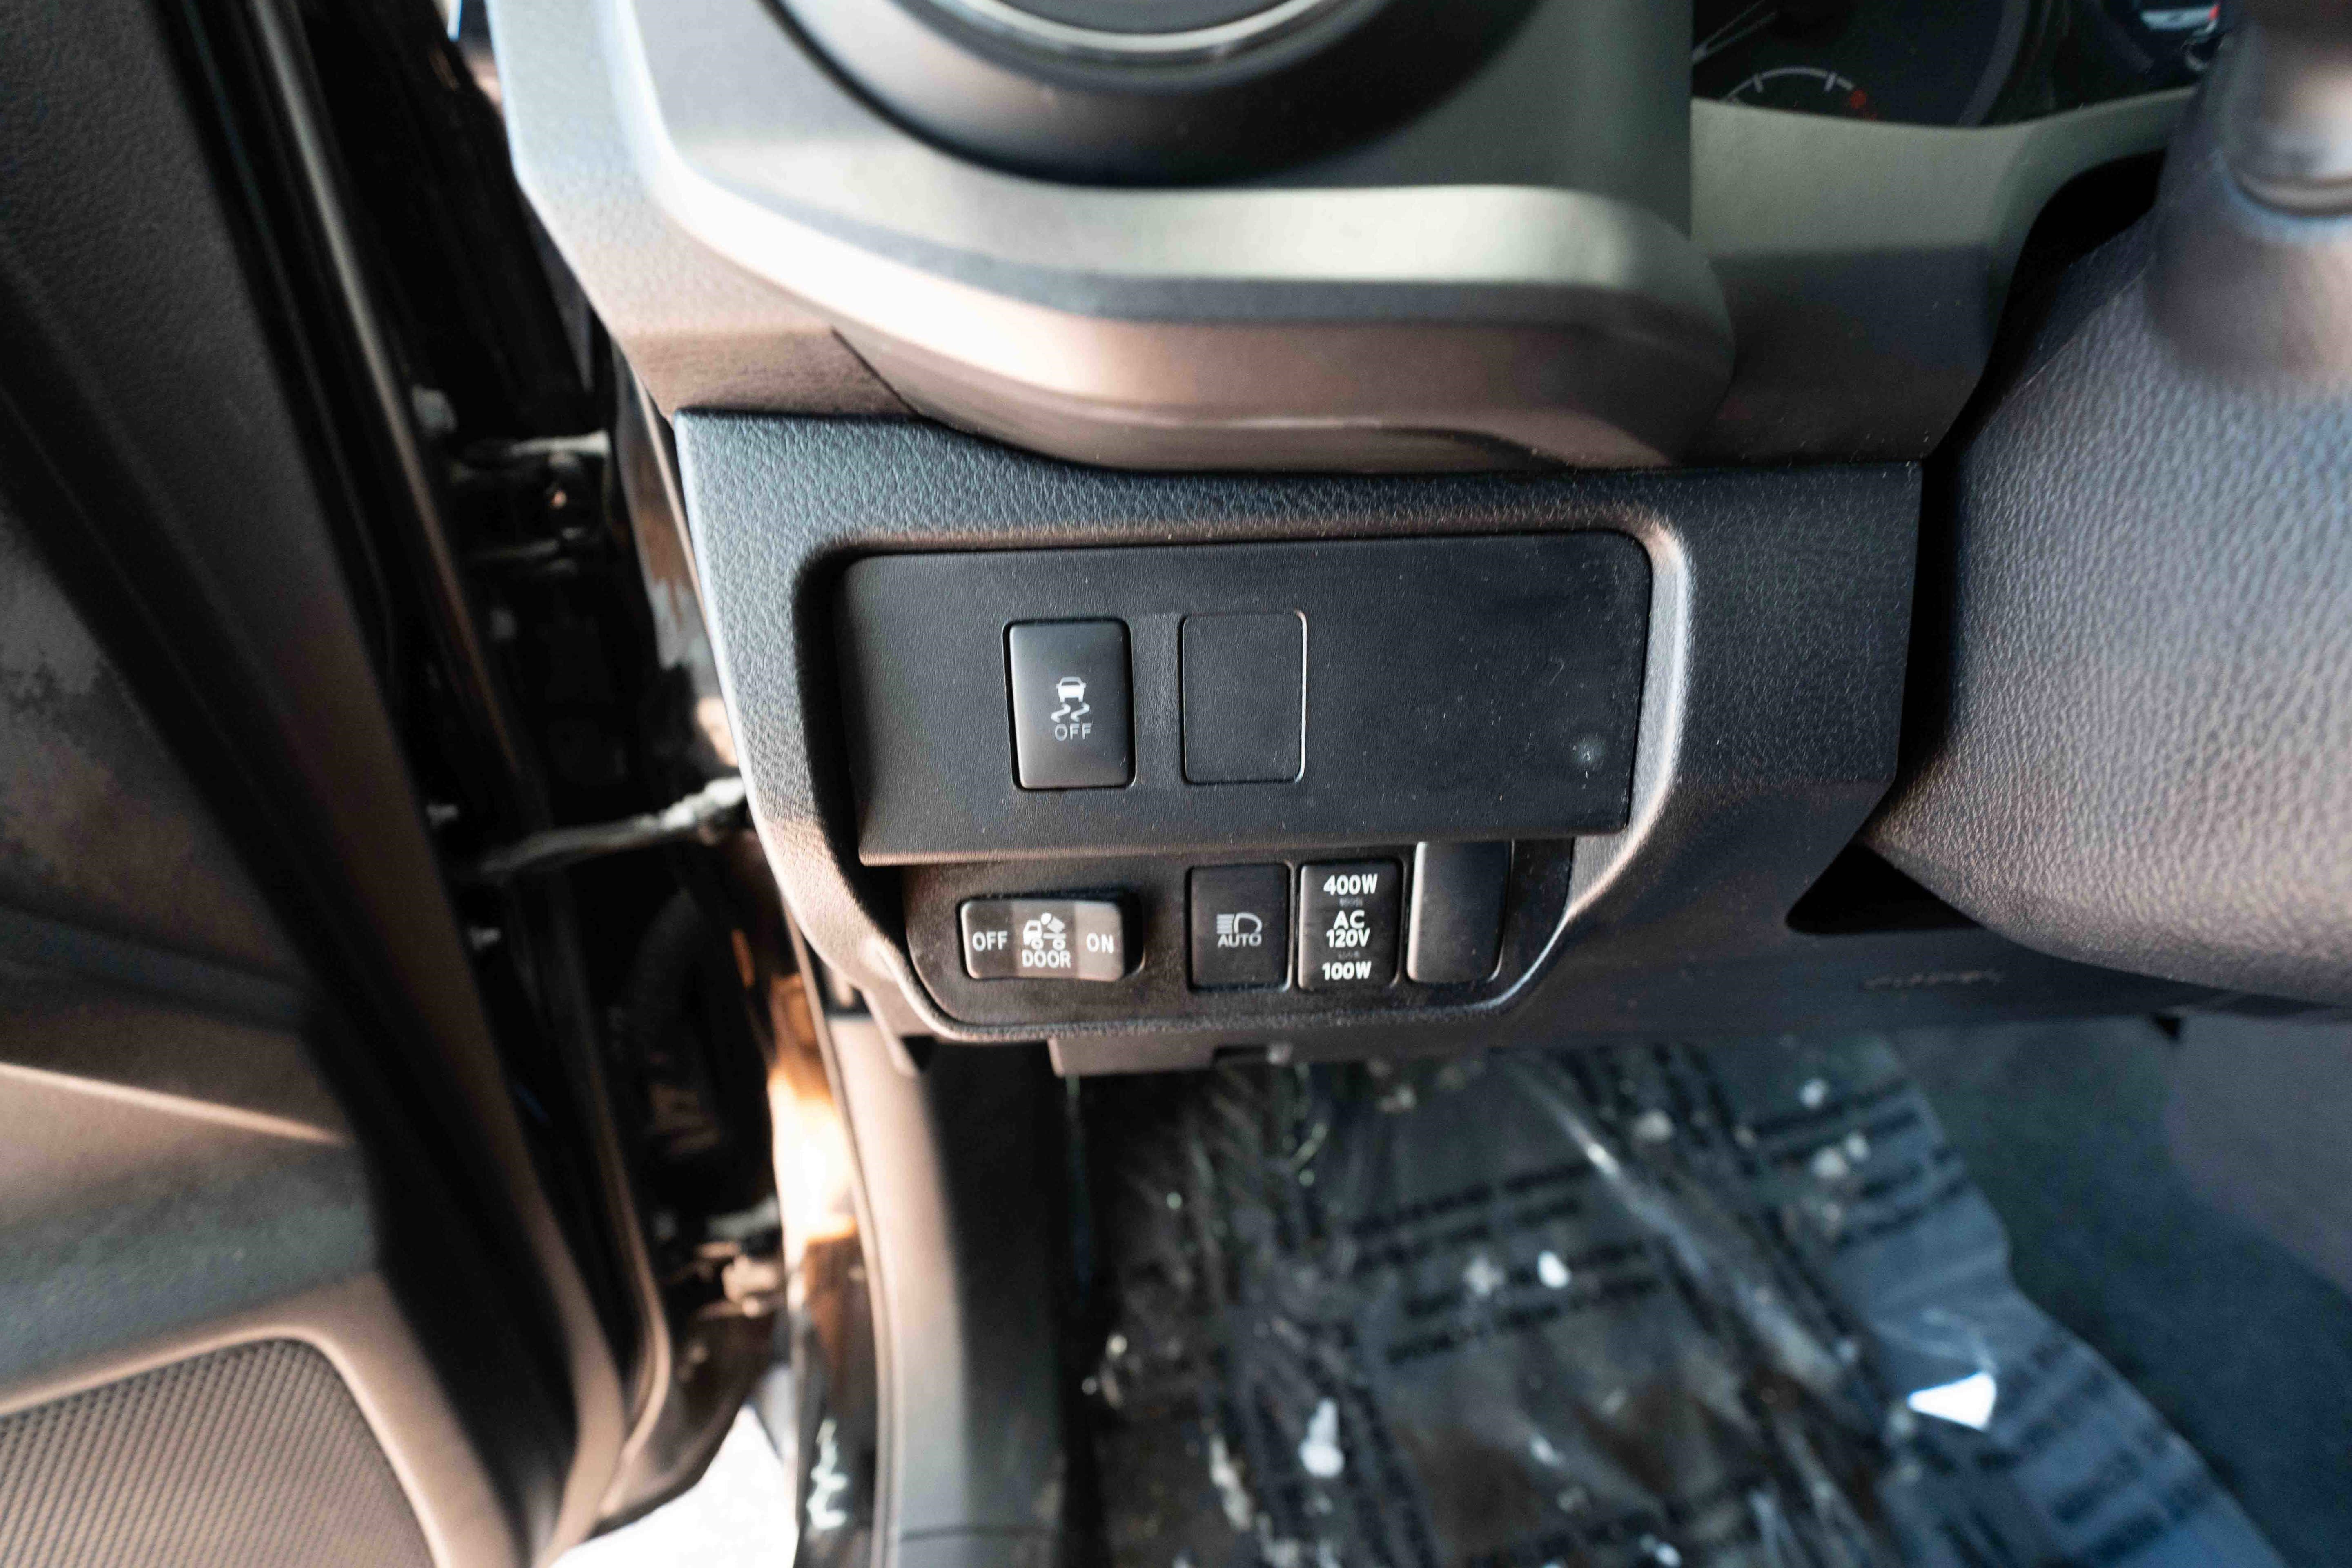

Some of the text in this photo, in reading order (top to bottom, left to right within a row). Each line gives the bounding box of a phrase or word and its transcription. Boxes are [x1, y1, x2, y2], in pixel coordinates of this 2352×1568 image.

[1055, 723, 1093, 741] OFF
[1323, 873, 1378, 895] 400W
[1333, 909, 1365, 930] AC
[972, 931, 1008, 952] OFF
[1086, 933, 1114, 954] ON
[1217, 933, 1262, 948] AUTO
[1326, 927, 1371, 948] 120V
[1022, 949, 1071, 968] DOOR
[1321, 961, 1372, 980] 100W
